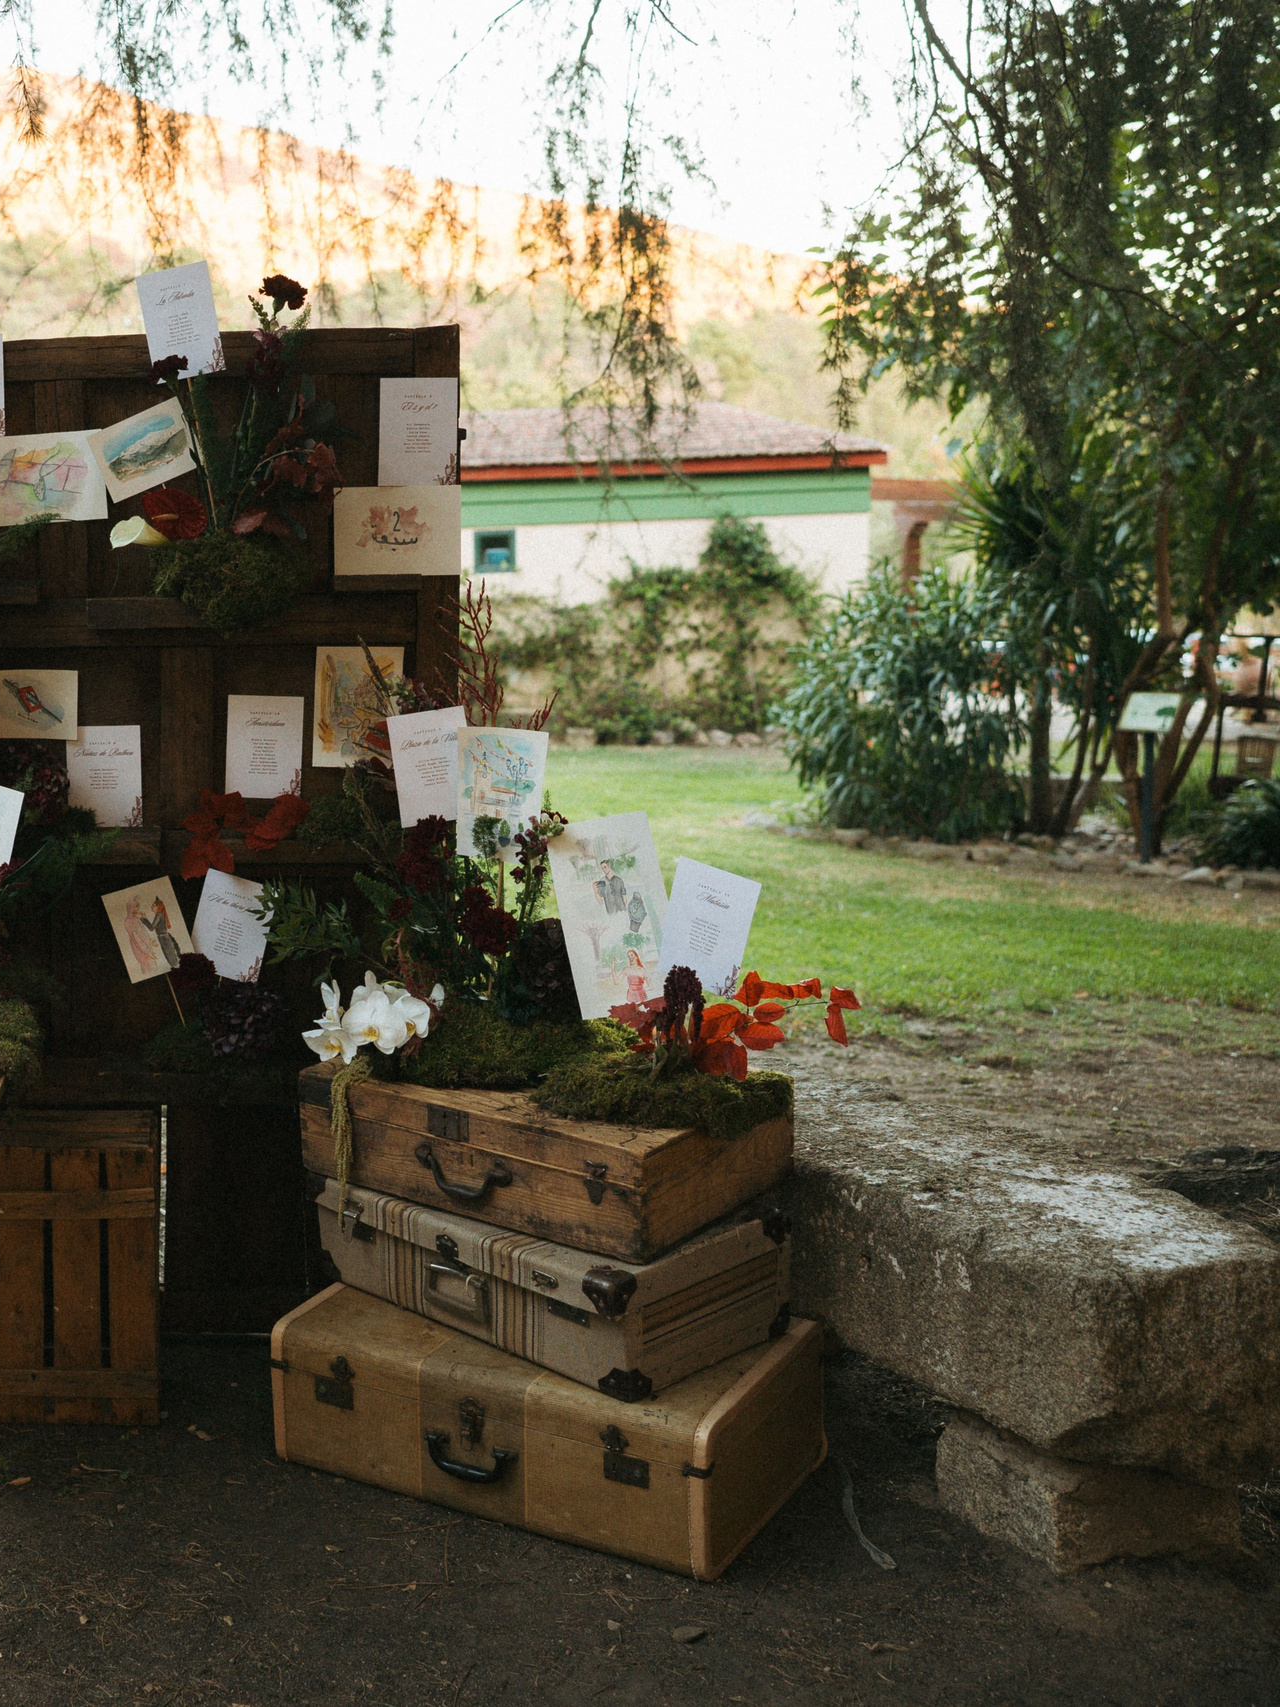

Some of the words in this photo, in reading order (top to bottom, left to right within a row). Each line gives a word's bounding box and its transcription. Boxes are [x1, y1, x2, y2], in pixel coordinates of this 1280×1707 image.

[155, 294, 167, 306] La
[168, 289, 196, 303] Adrada
[401, 401, 415, 411] El
[393, 511, 402, 532] 2
[245, 717, 286, 727] Amsterdam
[400, 739, 422, 751] Plaza
[423, 737, 431, 746] de
[432, 736, 440, 745] la
[108, 747, 134, 757] Balboa
[696, 892, 730, 910] Malasia
